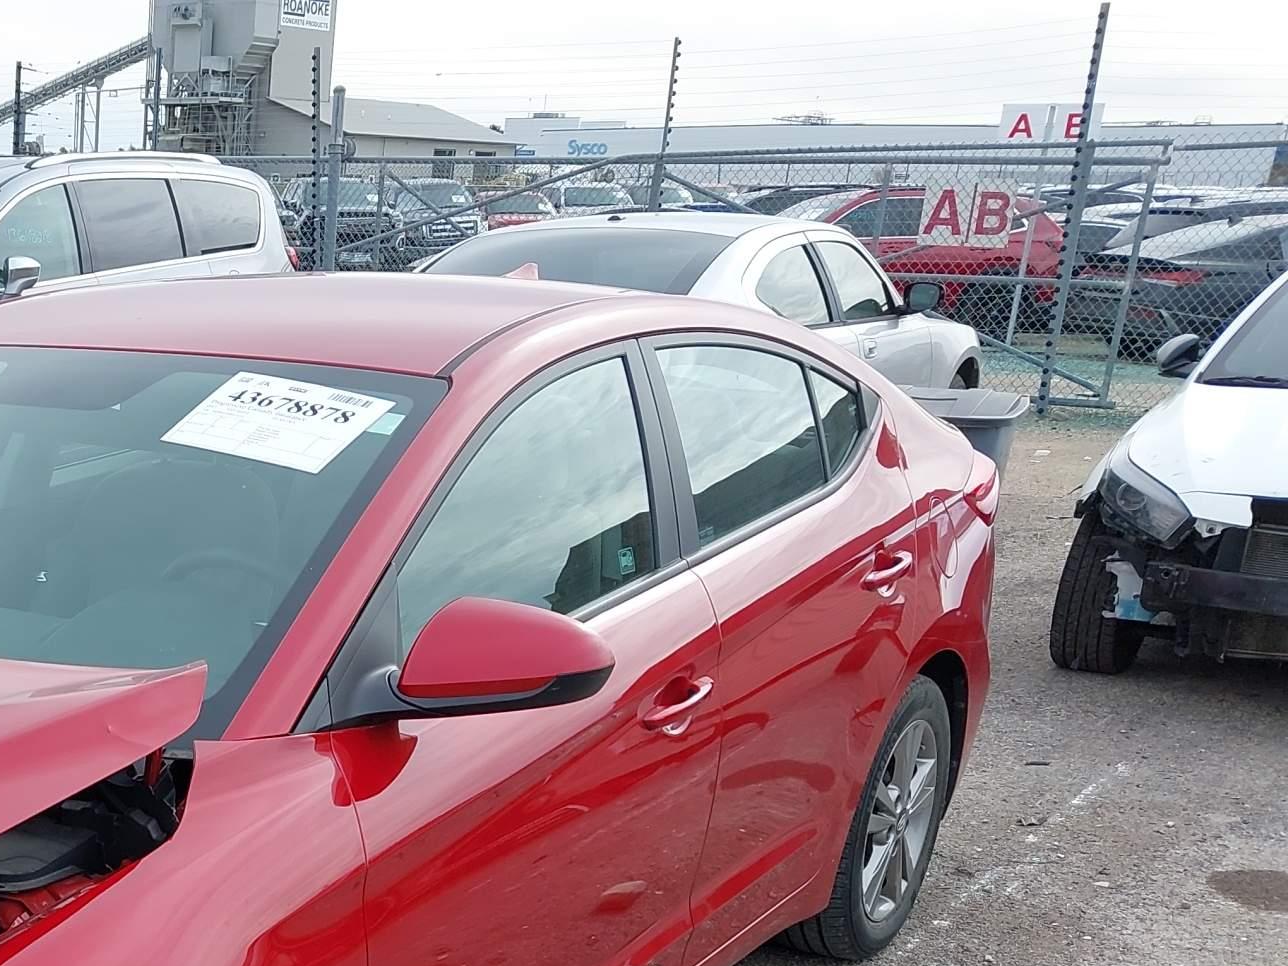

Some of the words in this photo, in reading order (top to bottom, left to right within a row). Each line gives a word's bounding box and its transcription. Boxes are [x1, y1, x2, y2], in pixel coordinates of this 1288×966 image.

[283, 0, 329, 16] ROANOKE
[281, 16, 304, 26] CONCRETE
[306, 20, 328, 29] PRODUCTS
[1008, 113, 1032, 138] A
[568, 139, 607, 156] Sysco
[227, 389, 357, 424] 43678878
